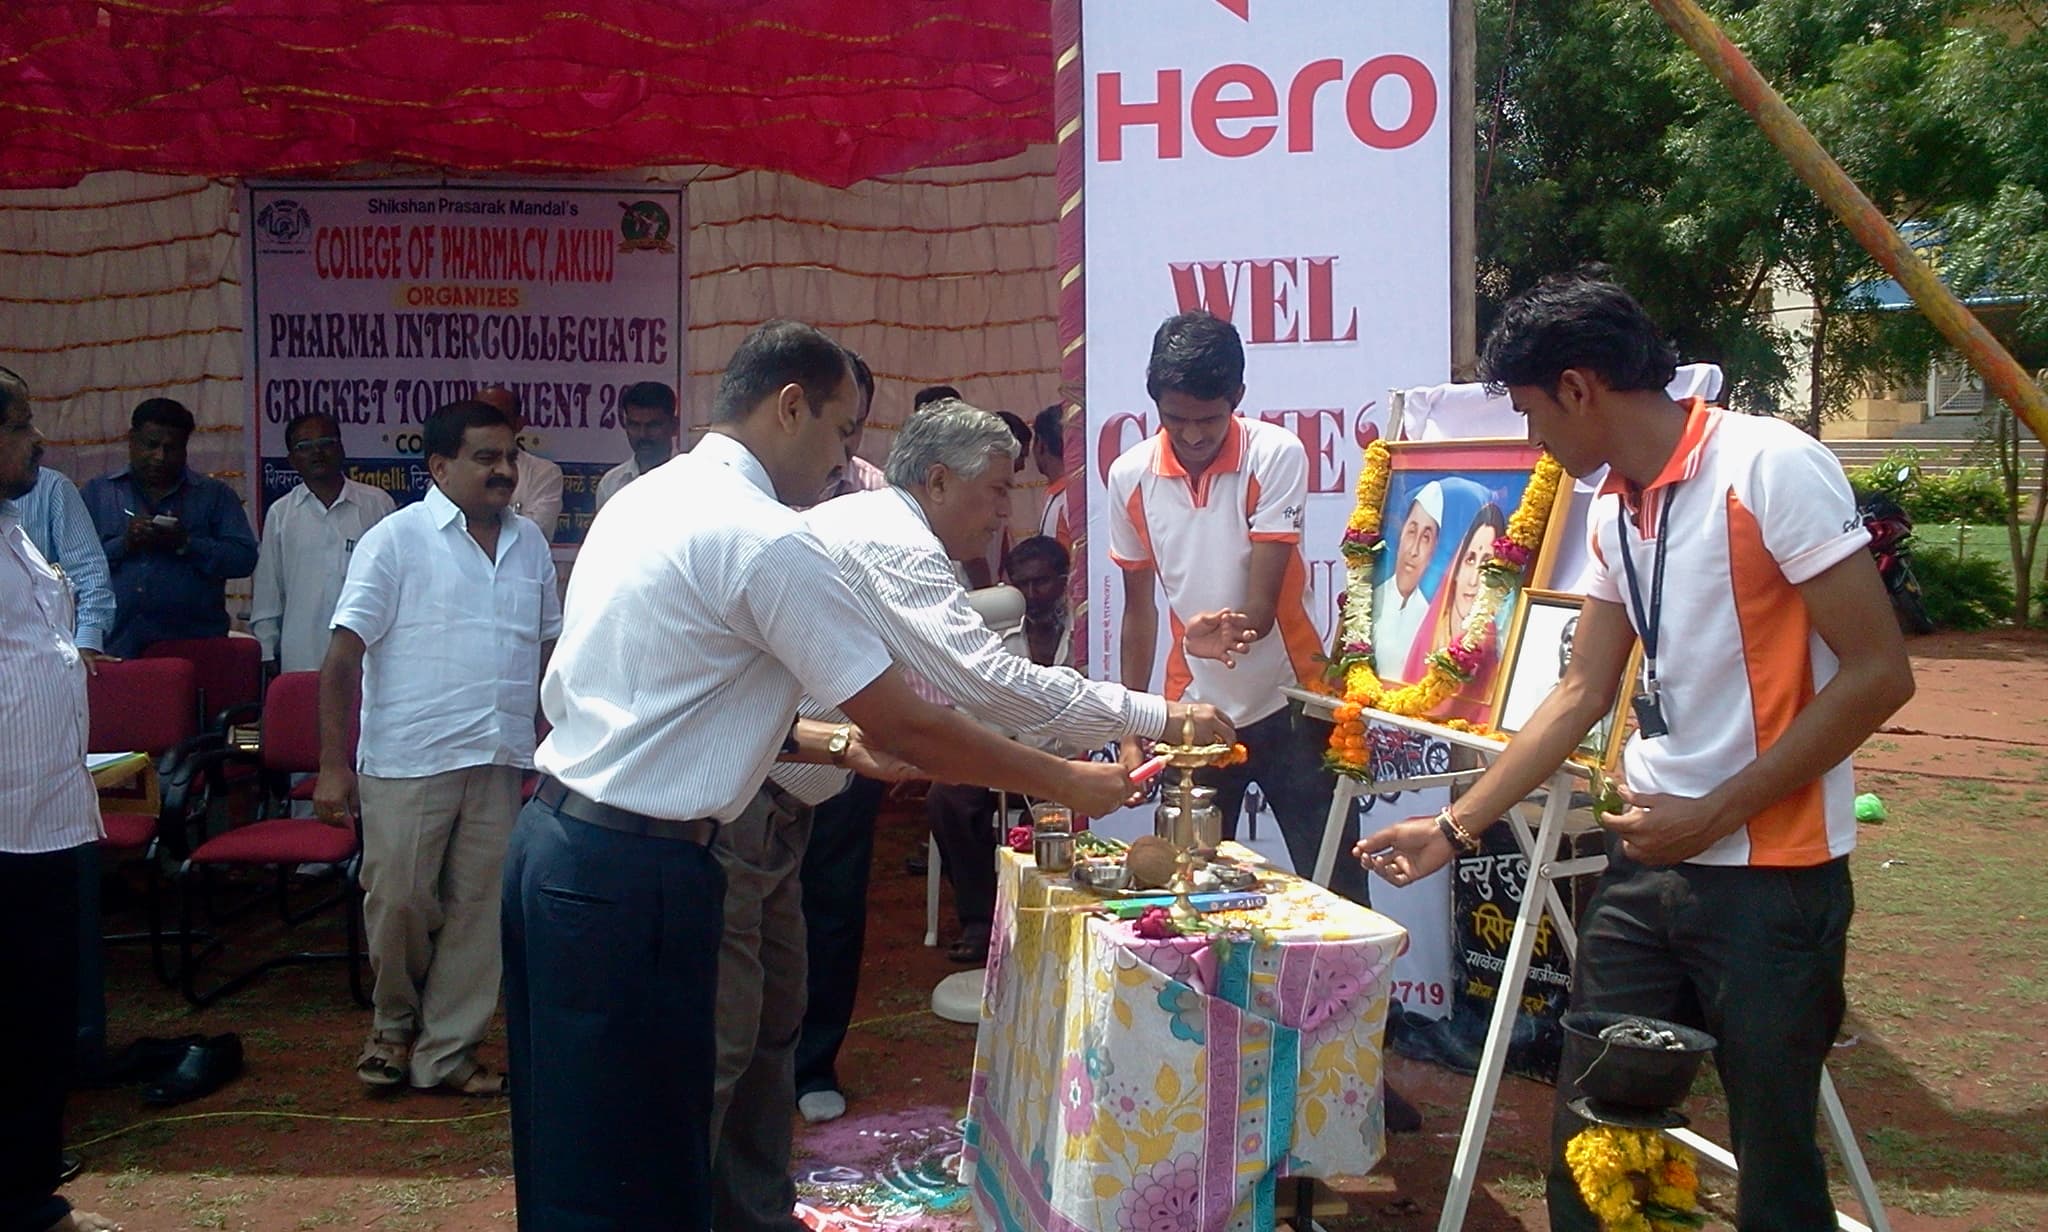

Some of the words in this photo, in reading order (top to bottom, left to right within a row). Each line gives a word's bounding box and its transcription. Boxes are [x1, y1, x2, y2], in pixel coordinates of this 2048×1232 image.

[1097, 54, 1438, 162] Hero
[368, 199, 435, 215] Shikshan
[438, 200, 506, 215] Prasarak
[510, 200, 578, 217] Mandal's
[315, 225, 402, 280] COLLEGE
[407, 225, 435, 279] OF
[407, 286, 520, 308] ORGANIZES
[1168, 256, 1358, 345] WEL
[269, 312, 390, 360] PHARMA
[394, 313, 668, 366] INTERCOLLEGIATE
[265, 378, 390, 425] CRICKET
